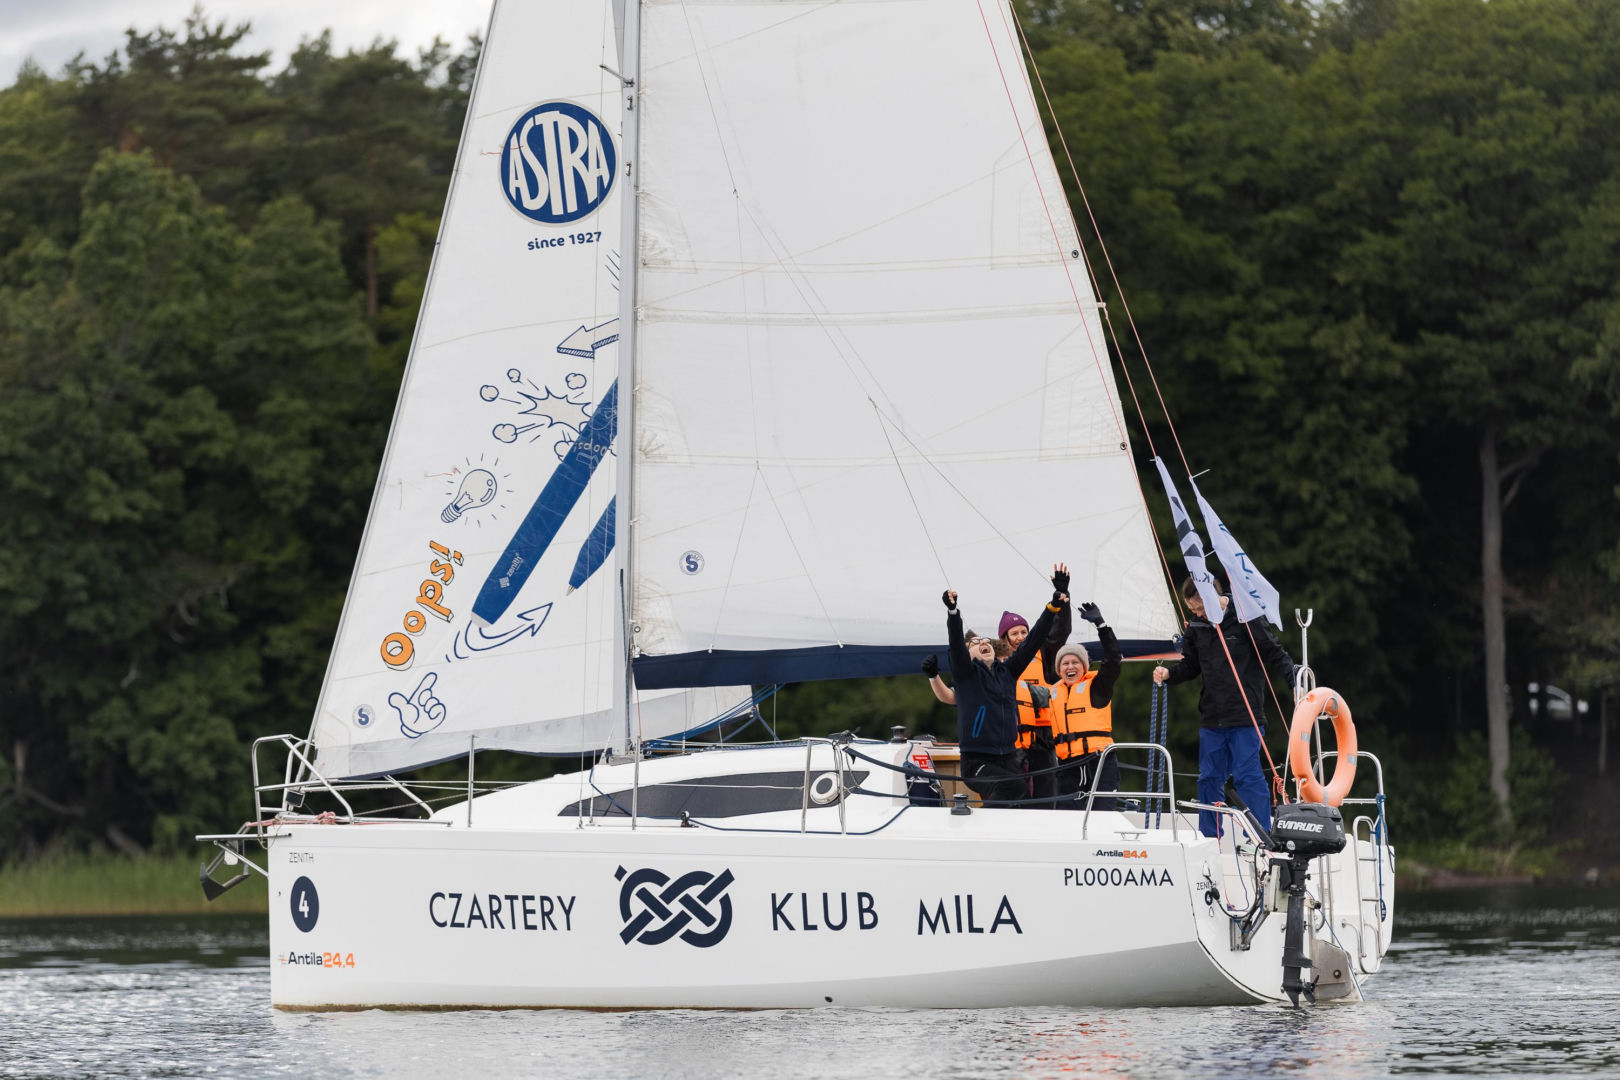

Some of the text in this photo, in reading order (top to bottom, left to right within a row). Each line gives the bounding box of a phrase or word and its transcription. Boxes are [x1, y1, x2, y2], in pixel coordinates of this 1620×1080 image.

[509, 110, 610, 216] ASTRA
[527, 231, 602, 251] since 1927
[380, 539, 464, 671] Oops!
[1277, 820, 1324, 833] EVINRUDE
[288, 852, 315, 864] ZENITH
[298, 890, 310, 919] 4
[429, 891, 1024, 936] CZARTERY KLUB MILA
